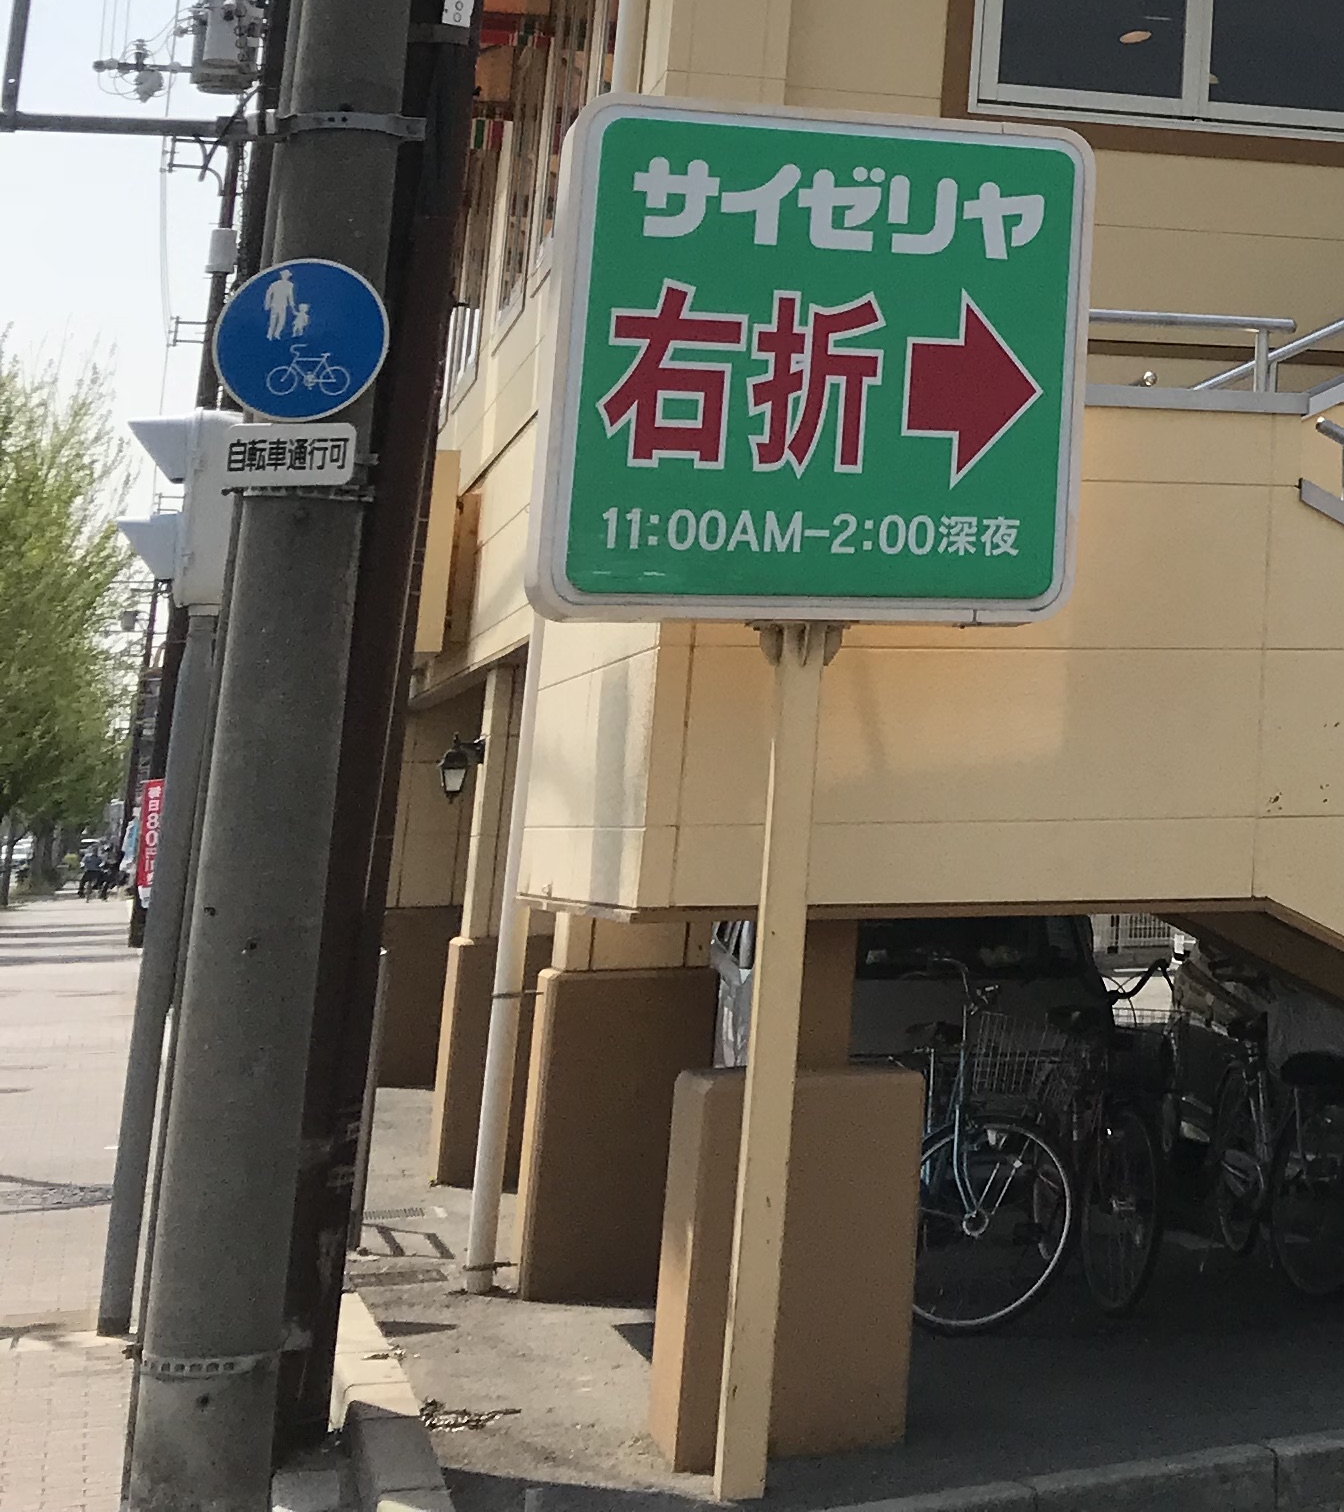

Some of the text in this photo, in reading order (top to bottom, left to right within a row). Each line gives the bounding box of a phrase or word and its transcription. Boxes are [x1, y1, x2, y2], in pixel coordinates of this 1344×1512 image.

[633, 155, 1045, 260] サイゼリヤ
[595, 277, 887, 479] 右折
[225, 437, 350, 472] 自転車通行可
